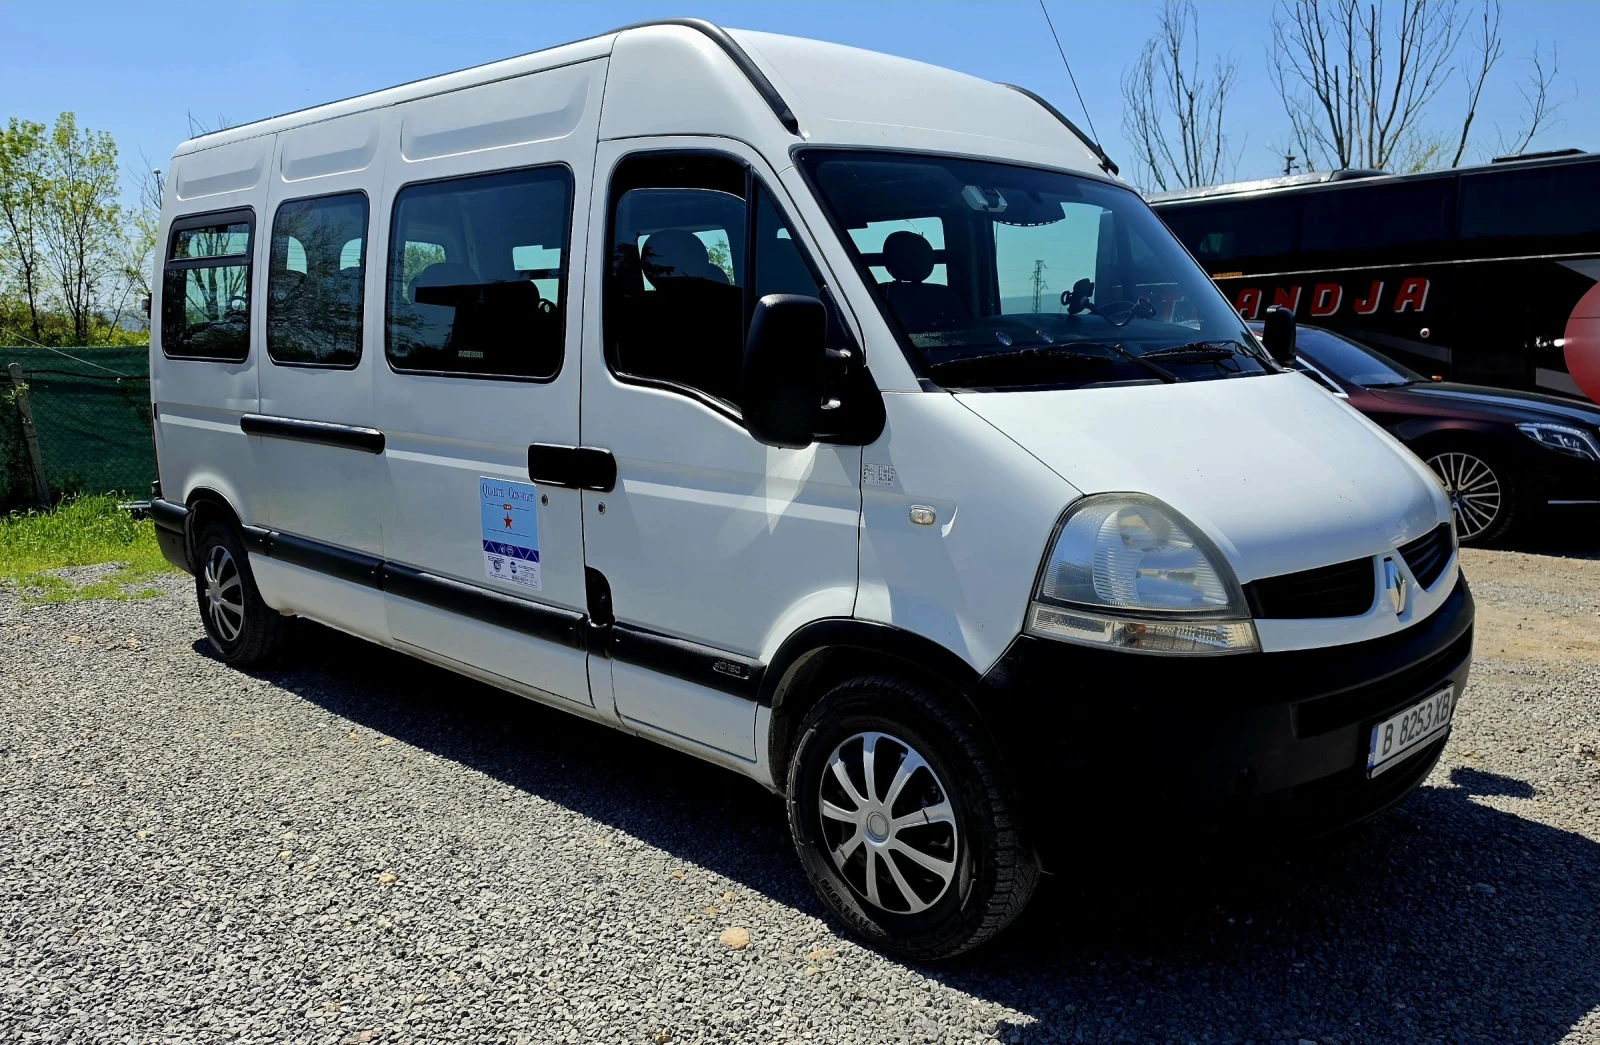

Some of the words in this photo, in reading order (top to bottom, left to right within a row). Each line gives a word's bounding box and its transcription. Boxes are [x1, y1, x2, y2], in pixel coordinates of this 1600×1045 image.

[1382, 723, 1394, 756] B
[1399, 702, 1433, 746] 8253
[1432, 692, 1451, 727] XB
